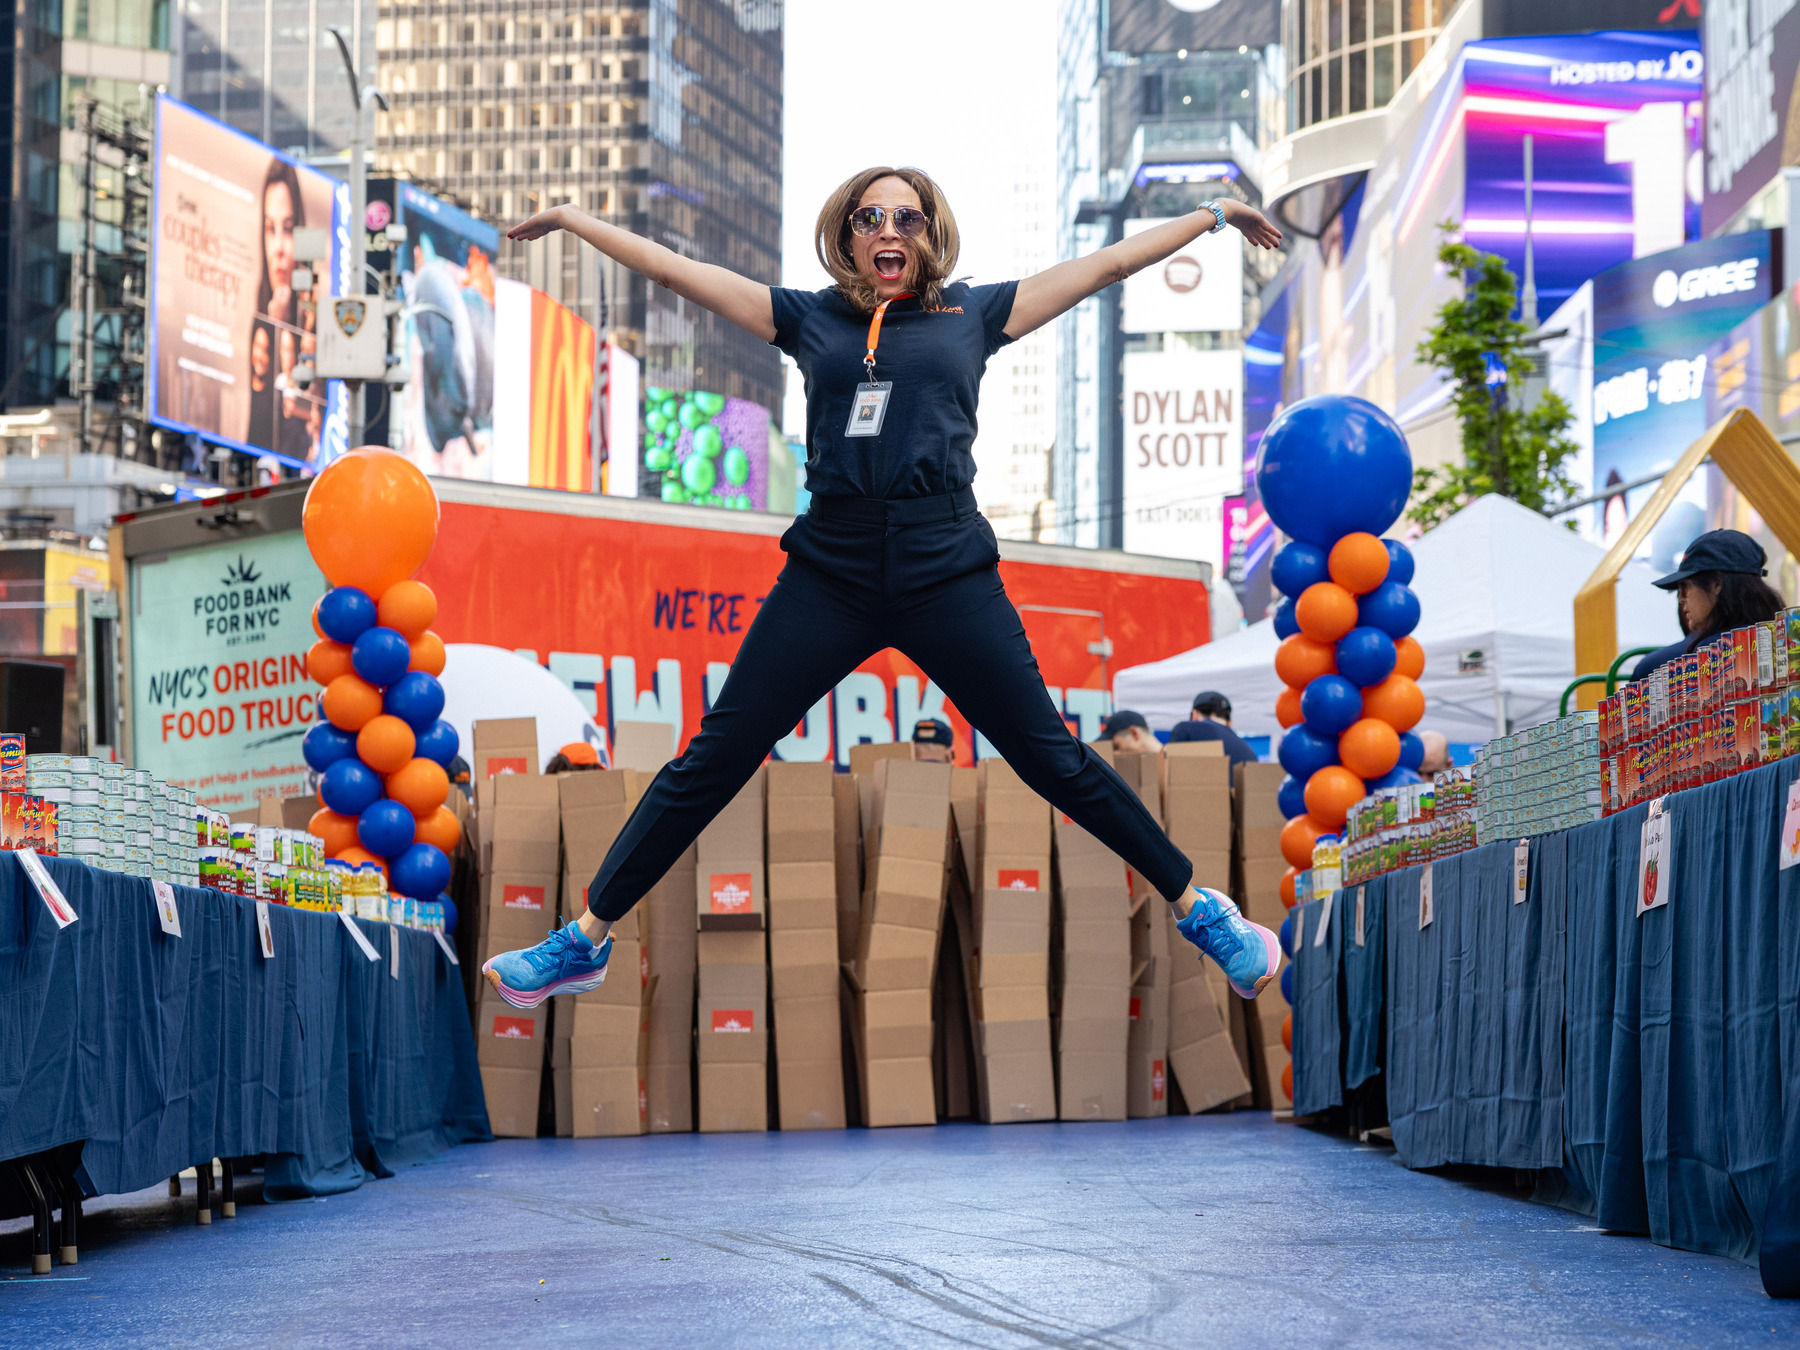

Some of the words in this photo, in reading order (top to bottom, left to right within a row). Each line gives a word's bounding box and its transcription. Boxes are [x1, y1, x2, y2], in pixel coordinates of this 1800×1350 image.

[1551, 60, 1635, 86] HOSTED
[164, 215, 220, 258] couples
[1678, 257, 1759, 302] GREE
[1133, 389, 1232, 425] DYLAN
[1138, 432, 1228, 468] SCOTT
[194, 590, 240, 616] FOOD
[243, 582, 291, 608] BANK
[653, 587, 745, 635] WE'RE
[206, 614, 240, 635] FOR
[244, 607, 280, 631] NYC
[148, 664, 209, 709] NYC'S
[213, 652, 314, 694] ORIGIN
[161, 706, 235, 744] FOOD
[240, 692, 321, 732] TRUC
